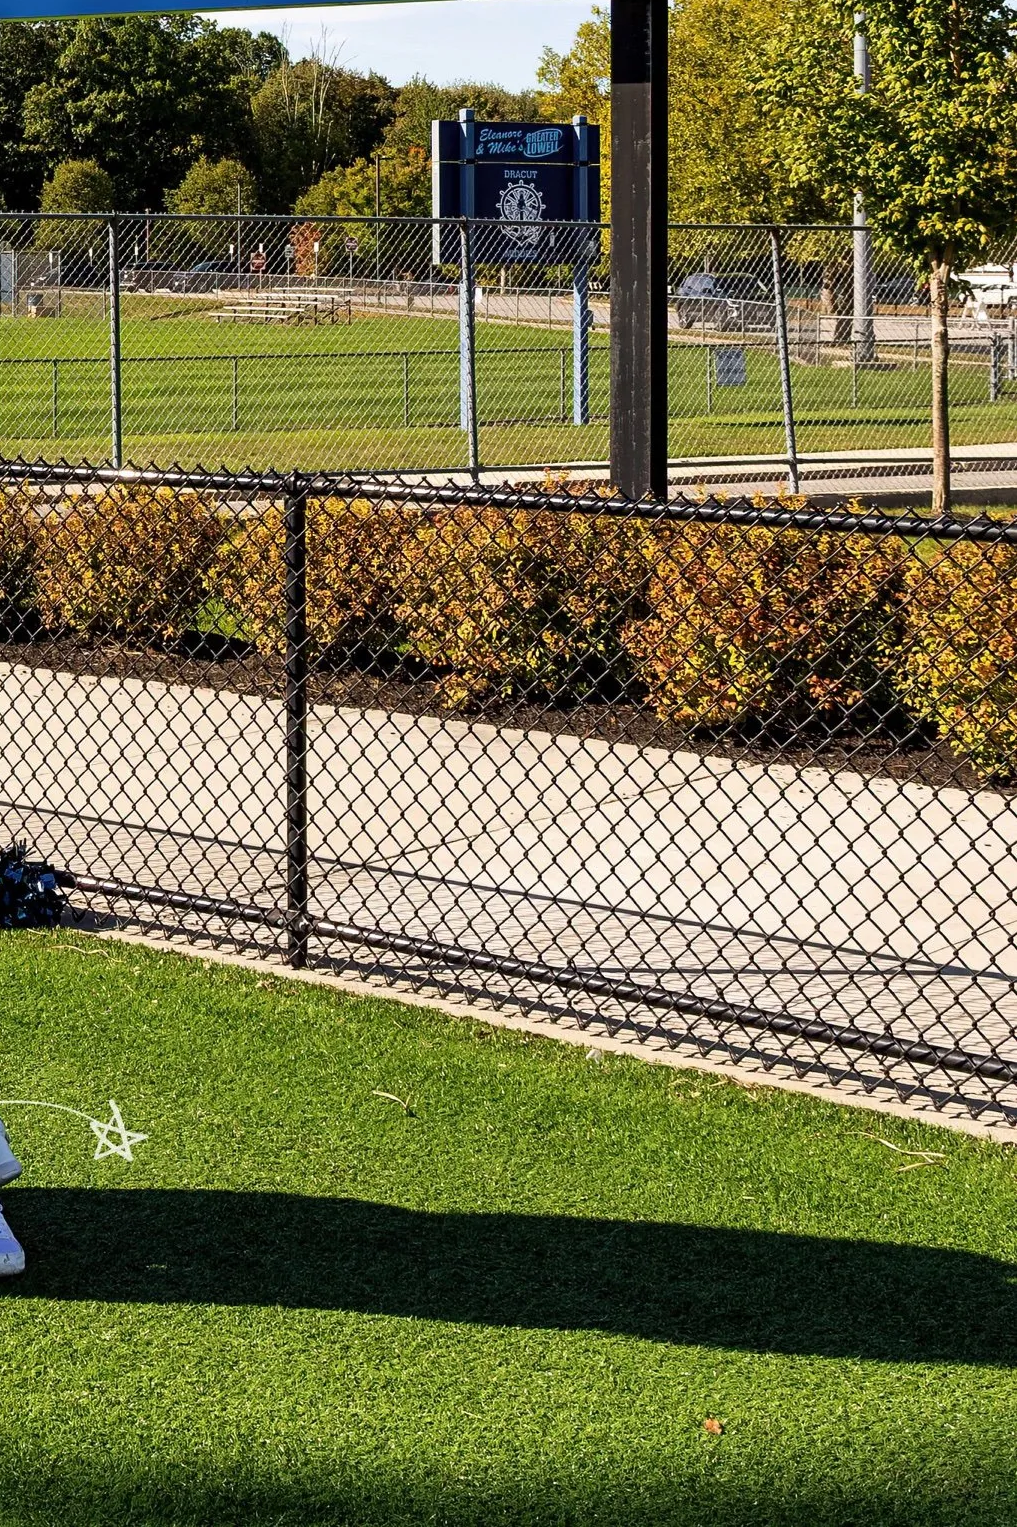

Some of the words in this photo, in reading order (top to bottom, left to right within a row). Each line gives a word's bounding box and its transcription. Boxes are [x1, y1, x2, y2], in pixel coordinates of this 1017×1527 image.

[525, 131, 559, 143] GREATER
[475, 143, 484, 155] &
[487, 139, 524, 154] Mike's
[527, 141, 559, 155] LOWELL
[504, 170, 538, 179] DRACUT
